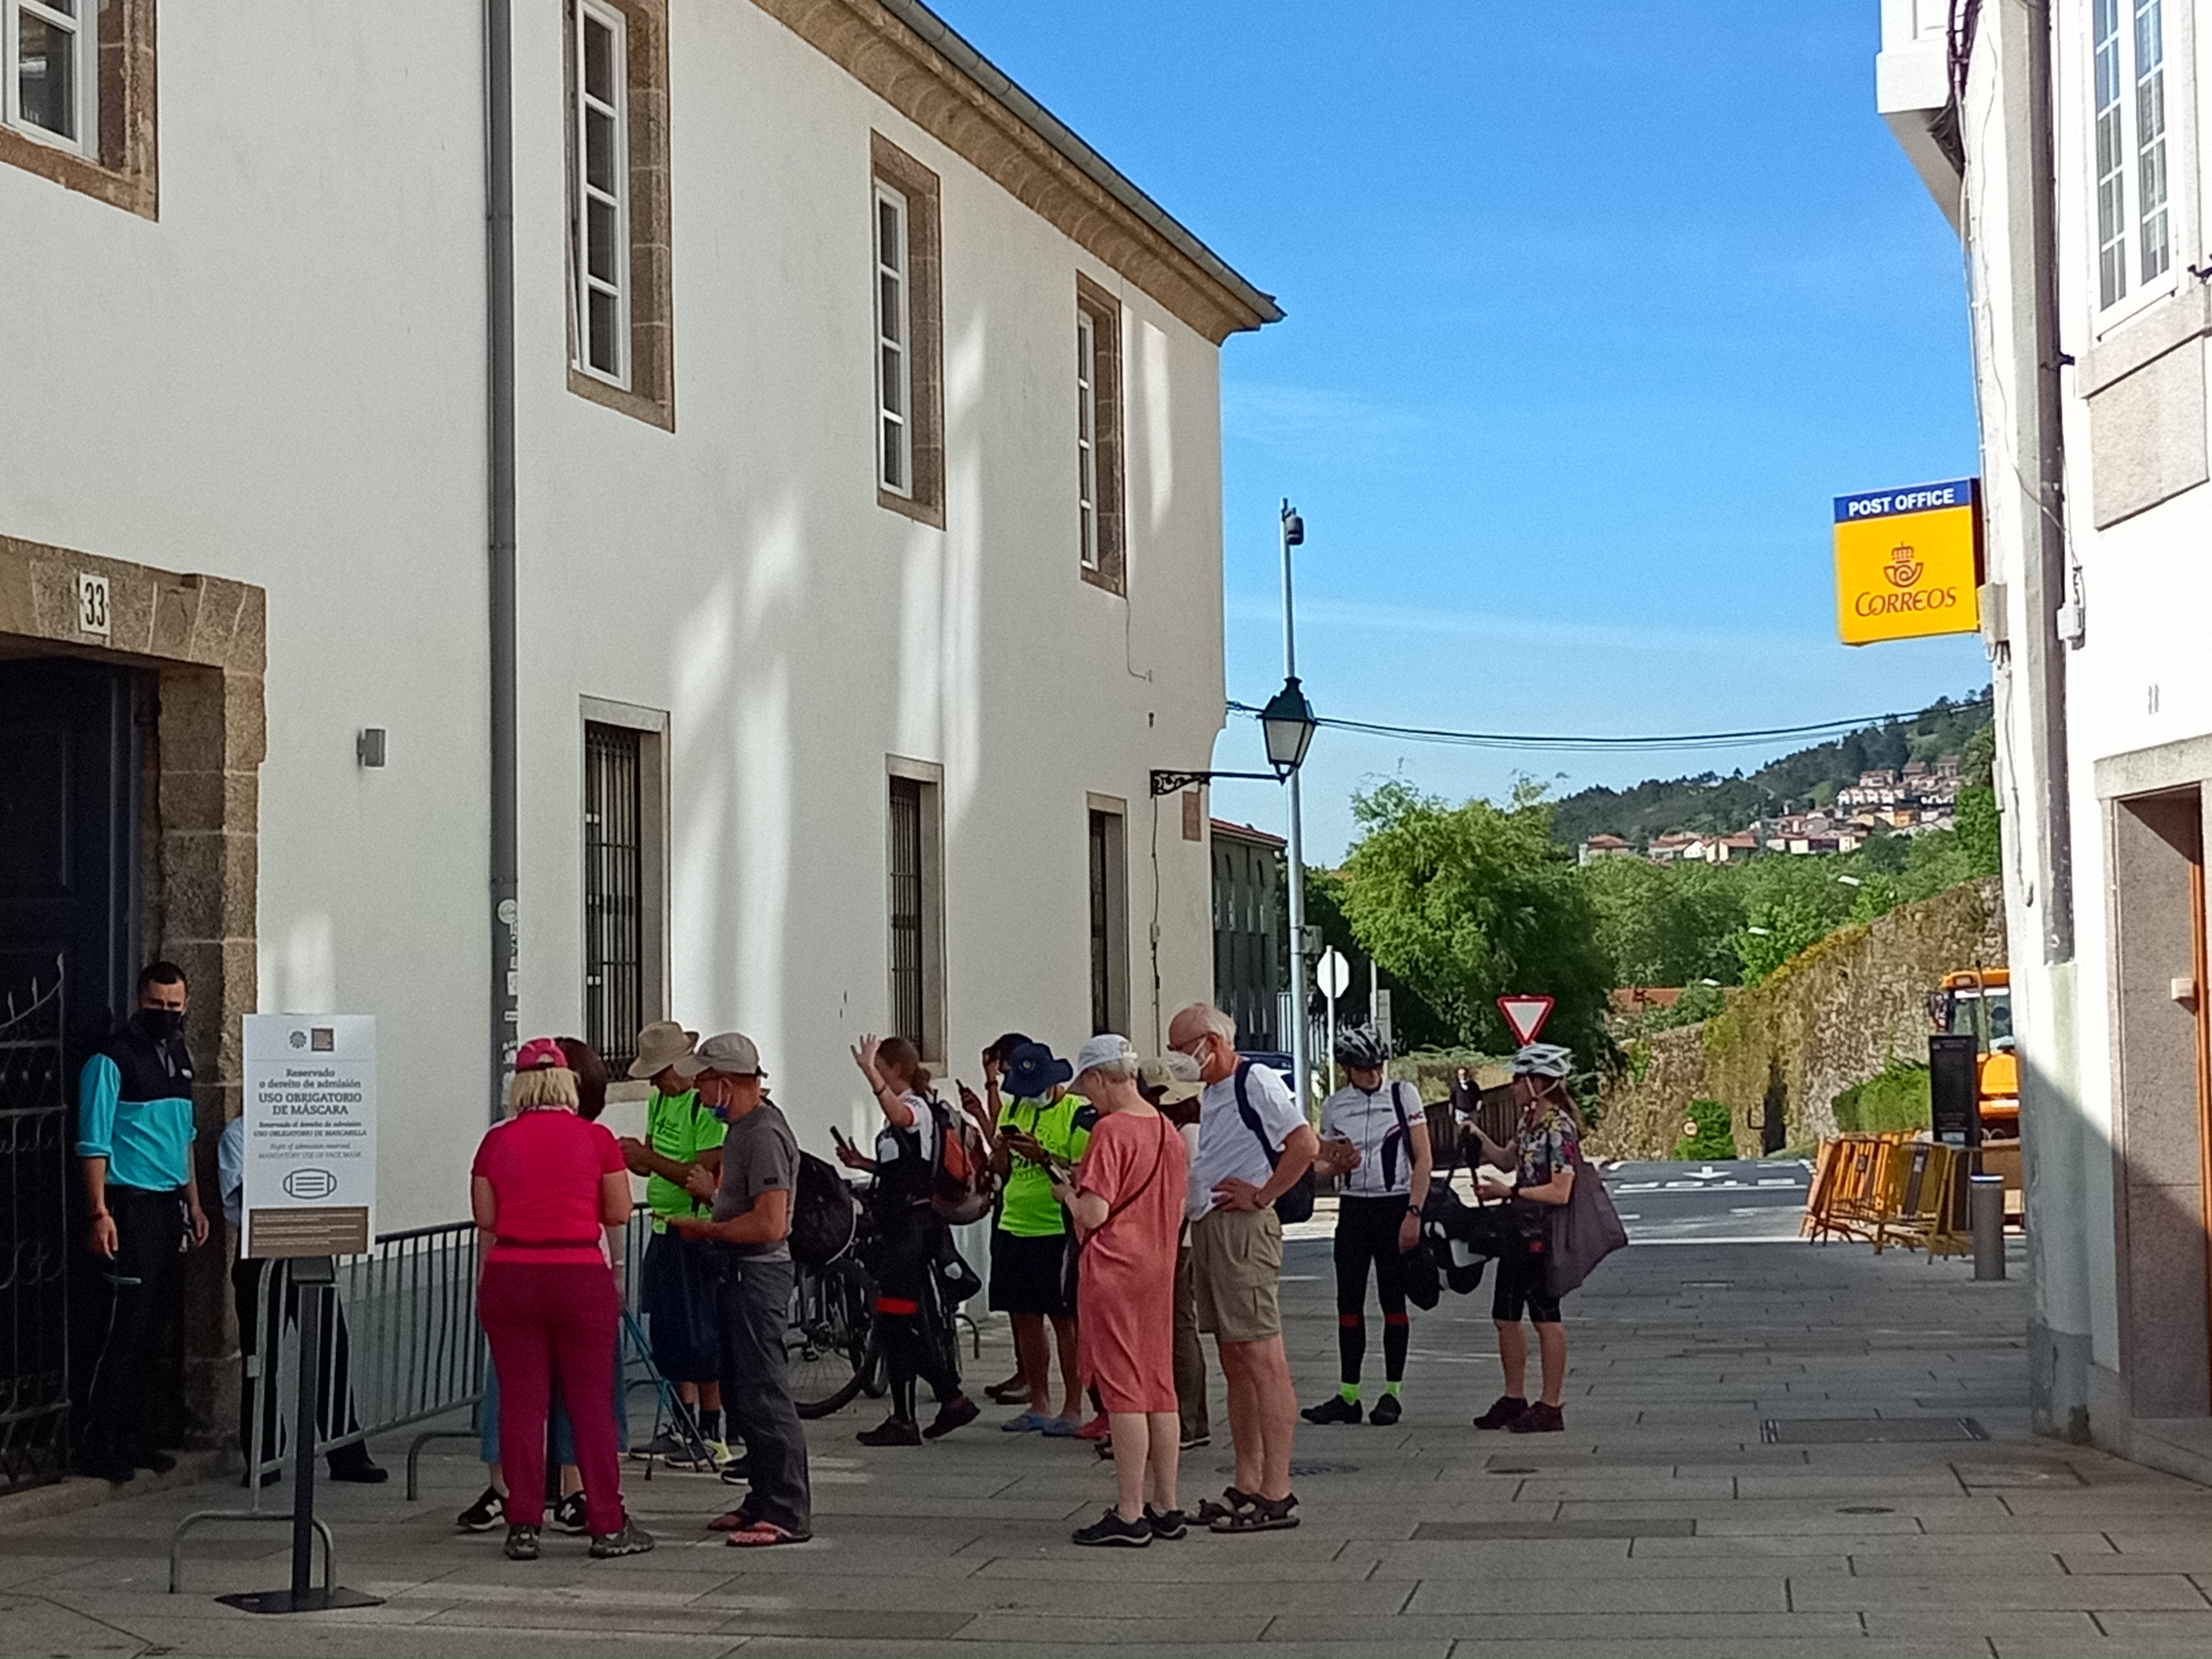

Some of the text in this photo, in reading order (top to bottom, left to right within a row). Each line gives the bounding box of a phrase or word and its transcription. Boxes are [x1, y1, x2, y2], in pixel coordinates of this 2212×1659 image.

[1848, 488, 1955, 517] POST OFFICE
[85, 582, 105, 627] 33
[1855, 586, 1957, 617] CORREOS
[285, 1068, 336, 1077] Reservado
[268, 1079, 301, 1088] dereito
[303, 1079, 315, 1088] de
[259, 1093, 362, 1103] USO OBRIGATORIO
[273, 1103, 348, 1115] DE MÁSCARA
